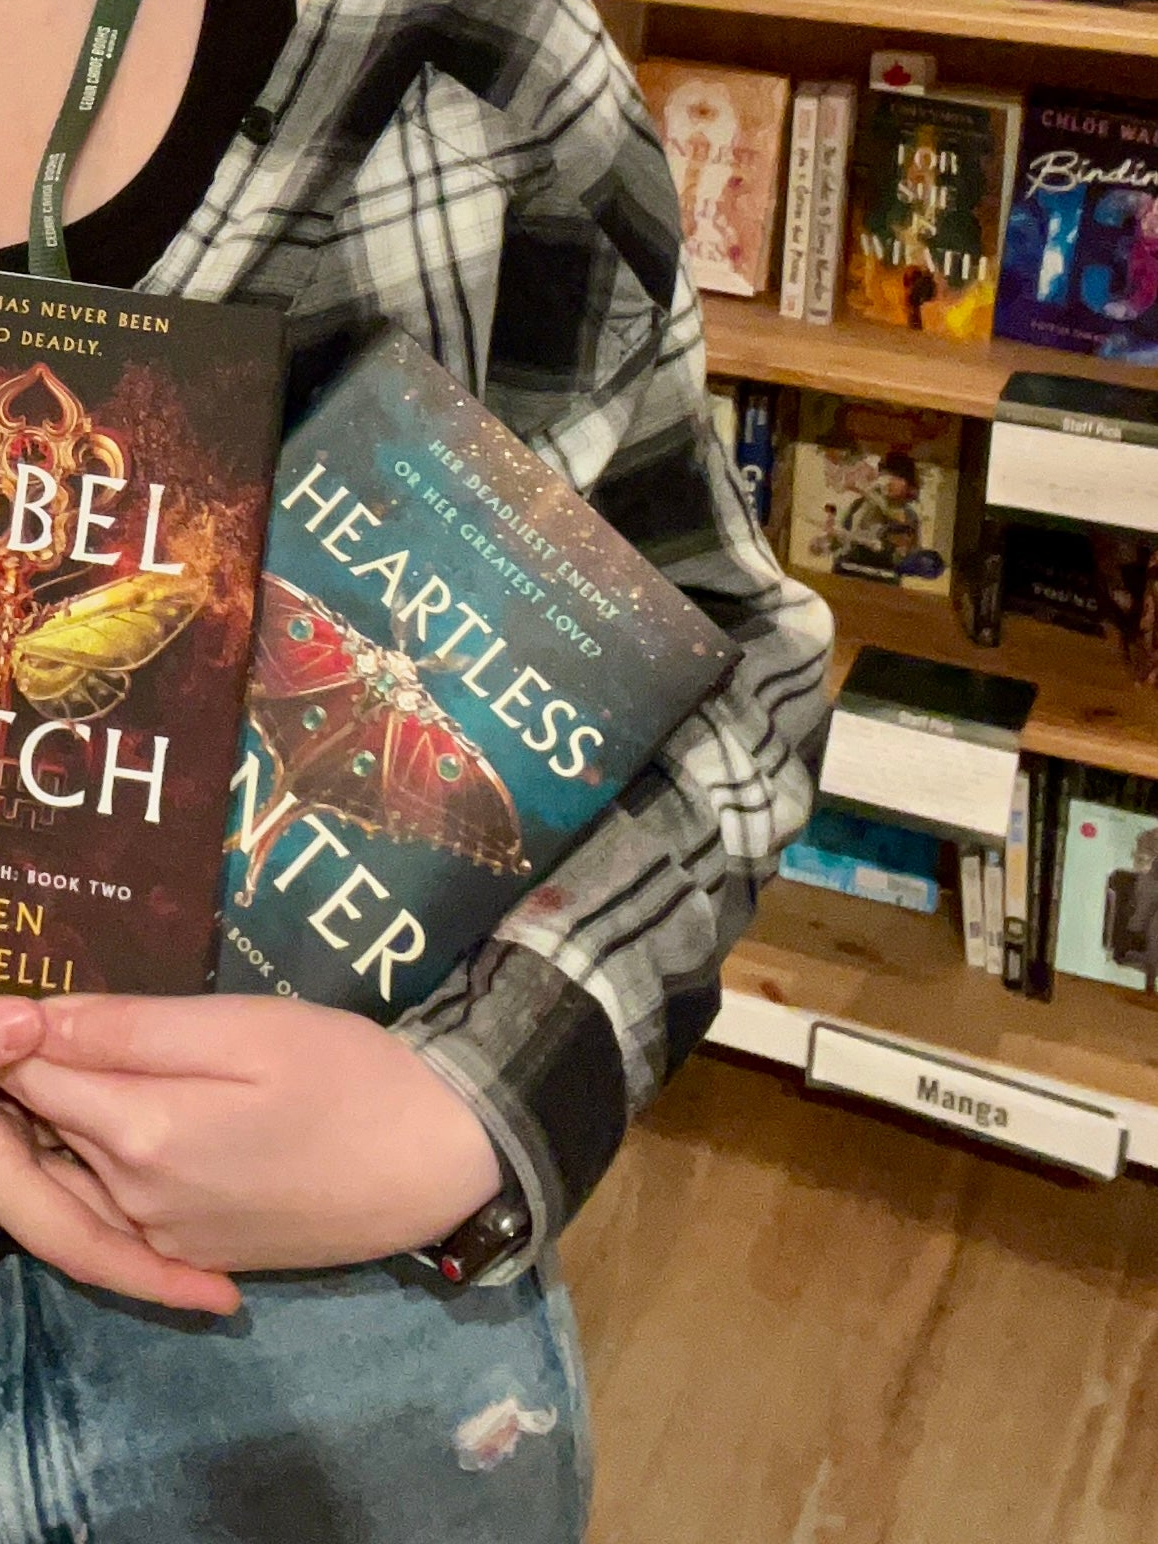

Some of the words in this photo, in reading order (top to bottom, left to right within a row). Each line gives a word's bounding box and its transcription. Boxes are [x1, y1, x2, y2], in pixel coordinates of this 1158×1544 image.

[91, 24, 112, 56] BOOKS
[1042, 109, 1109, 138] CHLOE
[1025, 150, 1158, 201] Bindin
[40, 300, 108, 326] NEVER
[118, 311, 171, 335] BEEN
[20, 330, 103, 358] DEADLY.
[429, 438, 460, 474] HER
[465, 474, 557, 562] DEADLIEST
[556, 547, 621, 622] ENEMY
[393, 459, 421, 489] OR
[421, 484, 459, 525] HER
[459, 523, 546, 608] GREATEST
[545, 605, 605, 660] LOVE?
[280, 462, 605, 781] HEARTLESS
[26, 869, 81, 893] BOOK
[89, 878, 134, 903] TWO
[228, 750, 428, 1003] NTER
[226, 926, 275, 978] BOOK
[915, 1075, 1010, 1129] Manga
